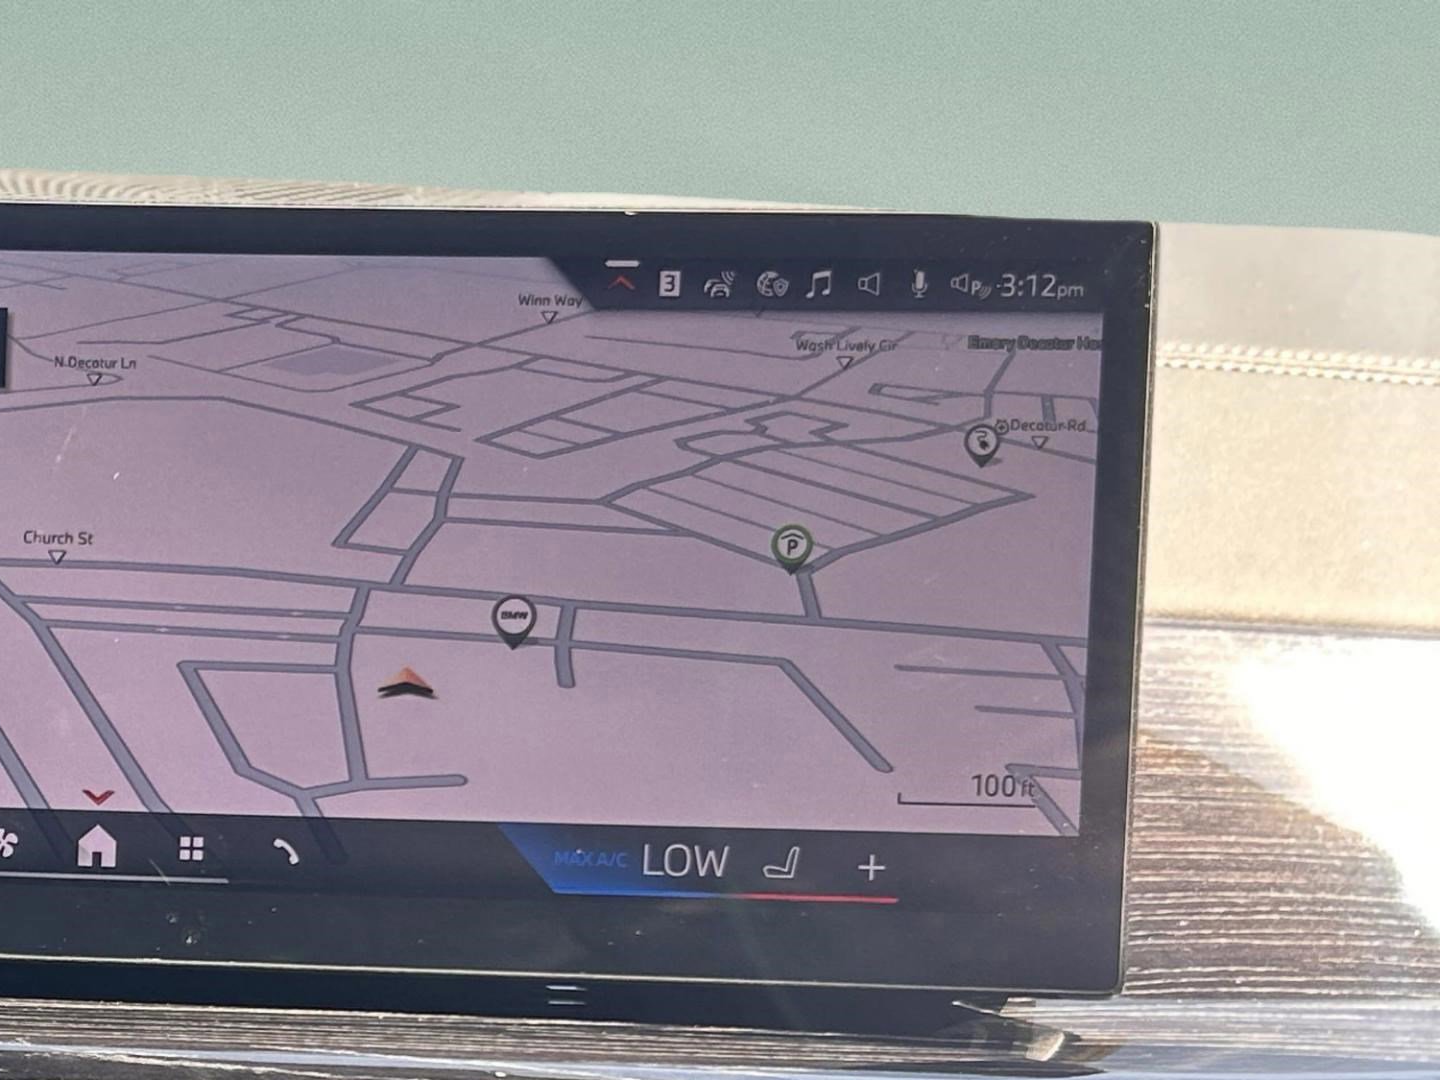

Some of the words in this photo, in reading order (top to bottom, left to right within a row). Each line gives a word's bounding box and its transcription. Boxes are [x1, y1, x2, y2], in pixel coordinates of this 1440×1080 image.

[518, 293, 550, 306] Winn
[554, 295, 584, 308] Way
[54, 356, 65, 368] N
[68, 357, 116, 370] Decatur
[120, 357, 137, 369] Ln
[1067, 419, 1087, 432] Rd
[23, 530, 74, 546] Church
[77, 531, 94, 546] St
[971, 774, 1017, 798] 100
[1020, 779, 1036, 798] ft
[642, 843, 729, 878] LOW
